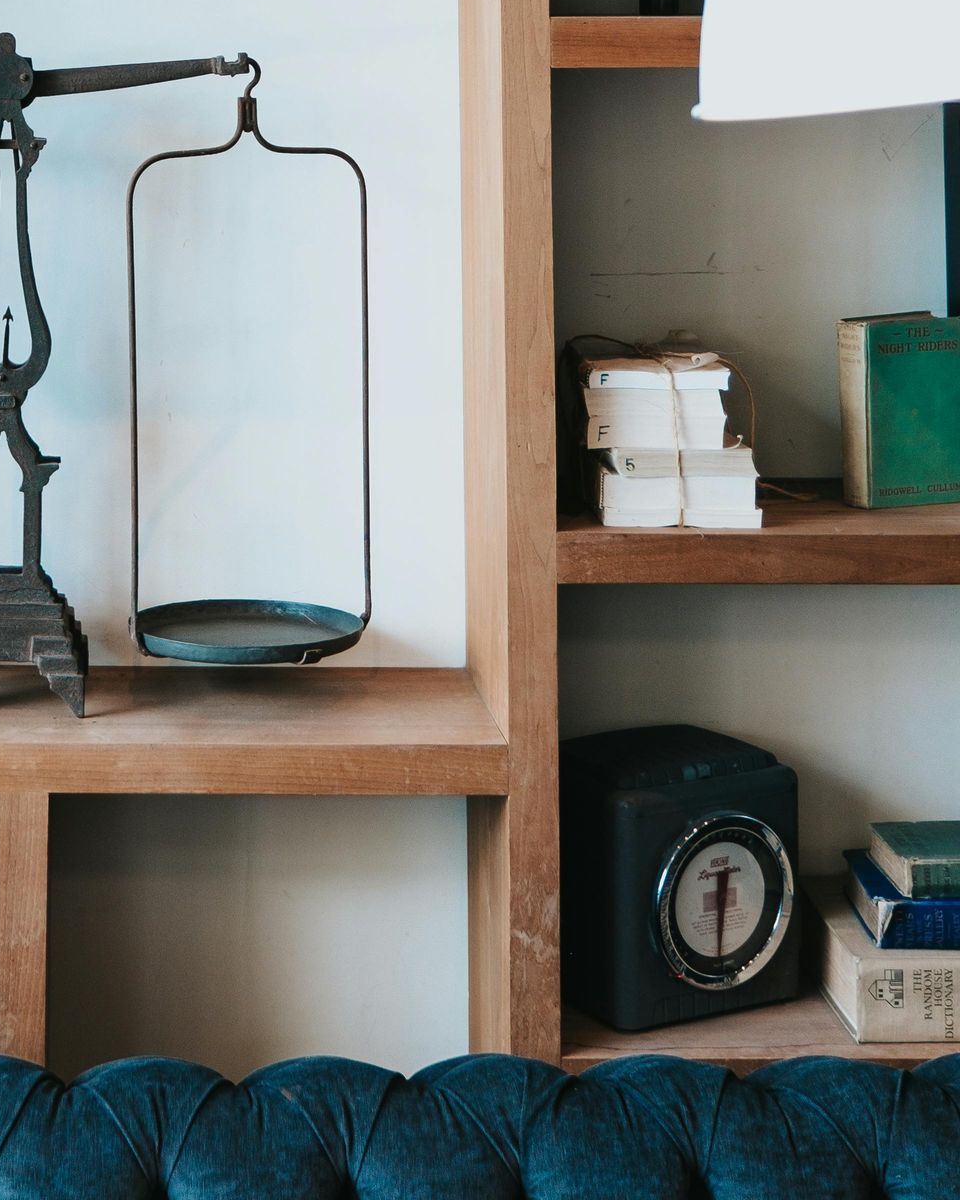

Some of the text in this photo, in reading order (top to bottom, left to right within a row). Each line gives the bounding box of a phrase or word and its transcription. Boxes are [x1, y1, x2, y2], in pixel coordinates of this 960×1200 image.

[906, 327, 930, 338] THE
[878, 340, 958, 353] NIGHT RIDERS
[600, 373, 609, 386] F
[597, 425, 610, 442] F
[625, 458, 636, 472] 5
[879, 486, 921, 497] RIDGWELL
[913, 969, 922, 993] THE
[934, 969, 942, 1007] HOUSE
[924, 969, 932, 1020] RANDOM
[945, 969, 954, 1039] DICTIONARY
